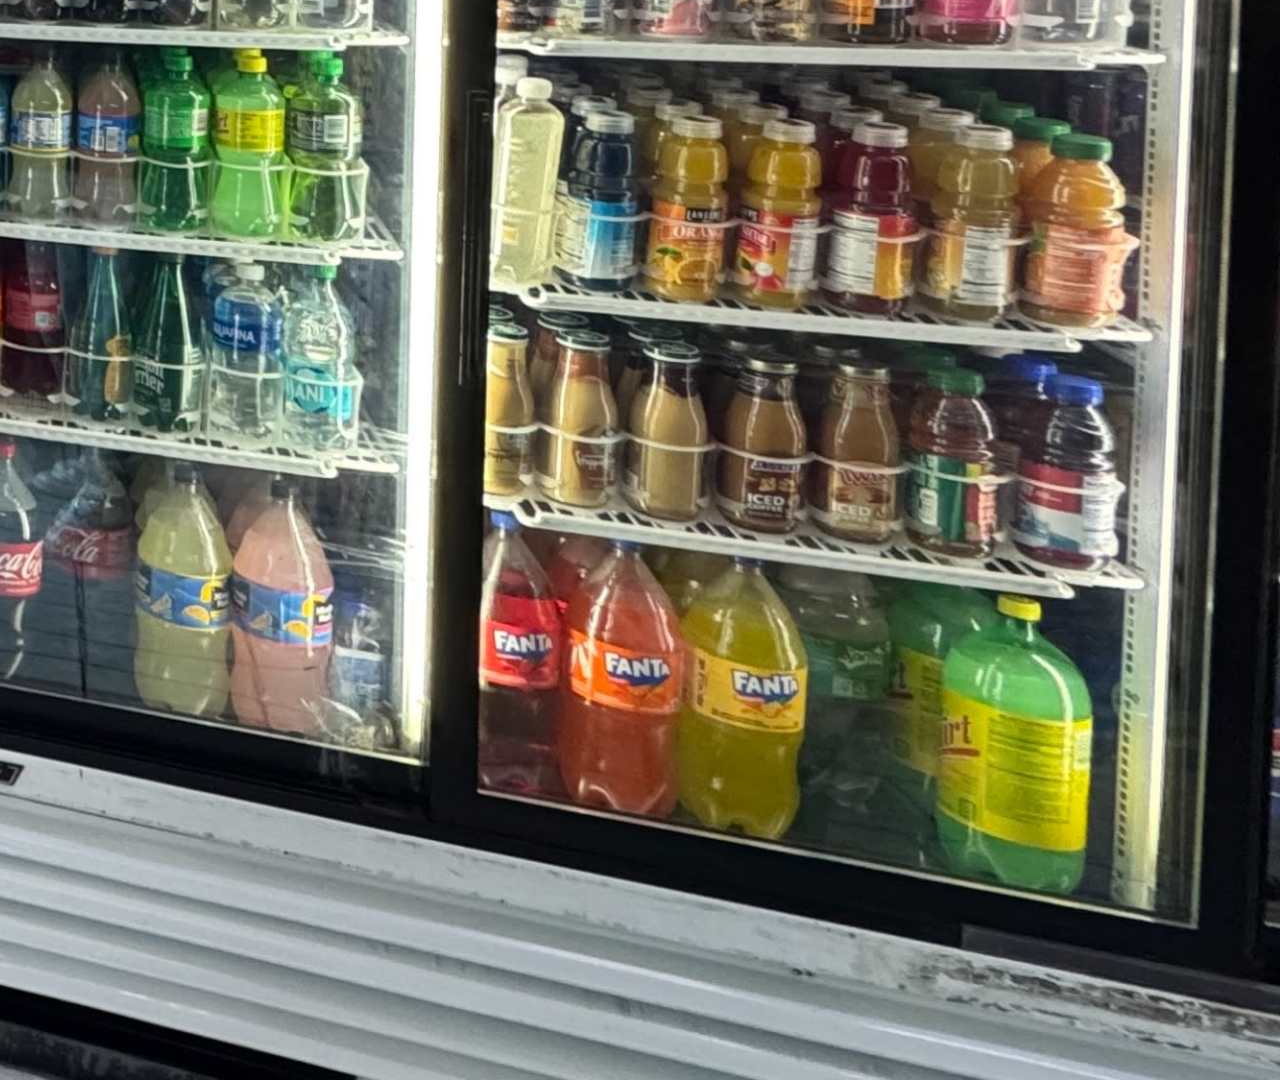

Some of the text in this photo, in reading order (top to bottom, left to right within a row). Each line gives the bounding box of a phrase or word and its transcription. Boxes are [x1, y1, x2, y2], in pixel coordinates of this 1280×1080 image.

[747, 492, 786, 505] ICED
[832, 501, 872, 516] ICED
[494, 629, 553, 653] FANTA
[604, 651, 671, 678] FANTA
[733, 669, 799, 696] FANTA
